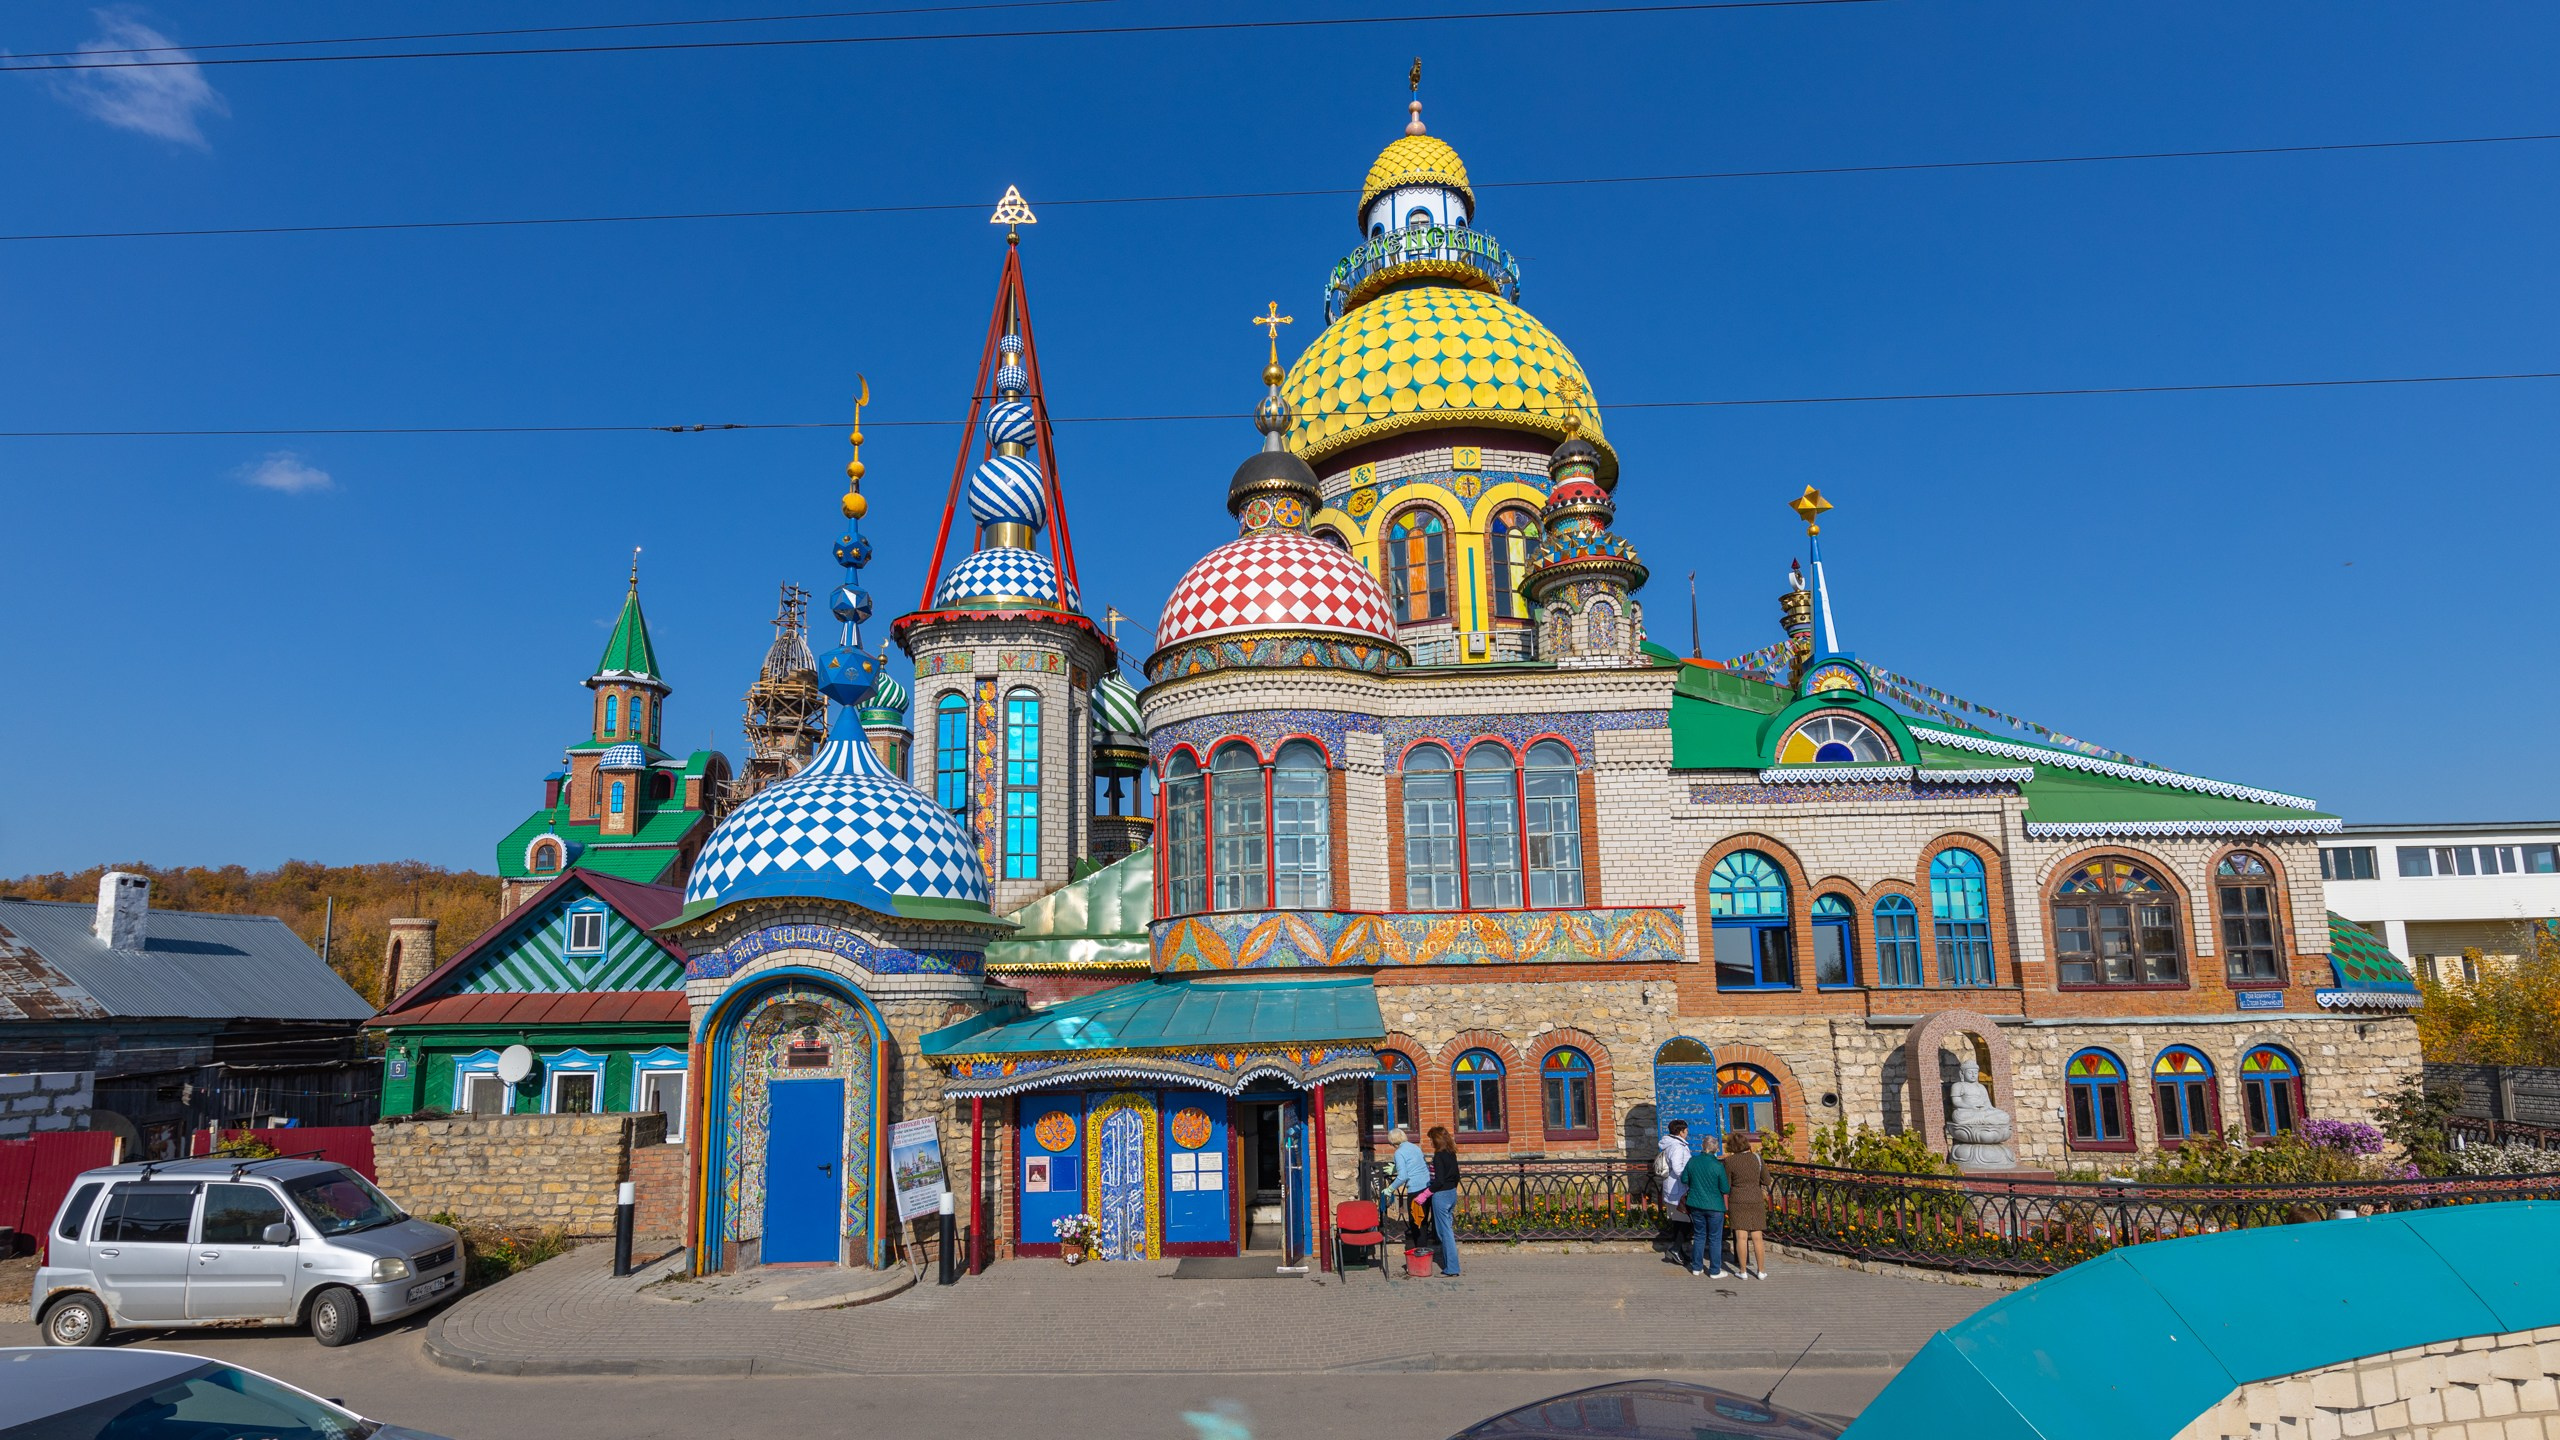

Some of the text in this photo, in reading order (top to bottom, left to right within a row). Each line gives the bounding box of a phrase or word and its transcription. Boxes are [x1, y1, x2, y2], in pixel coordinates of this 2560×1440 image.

[1330, 227, 1501, 290] СЕЛЕНСКИЙ
[1384, 918, 1483, 934] БОГАТСТВО
[1492, 916, 1553, 932] ХРАМА
[1560, 916, 1592, 930] ЭТО
[1446, 940, 1507, 955] ЛЮДЕЙ
[1516, 939, 1550, 954] ЭТО
[1556, 939, 1569, 953] И
